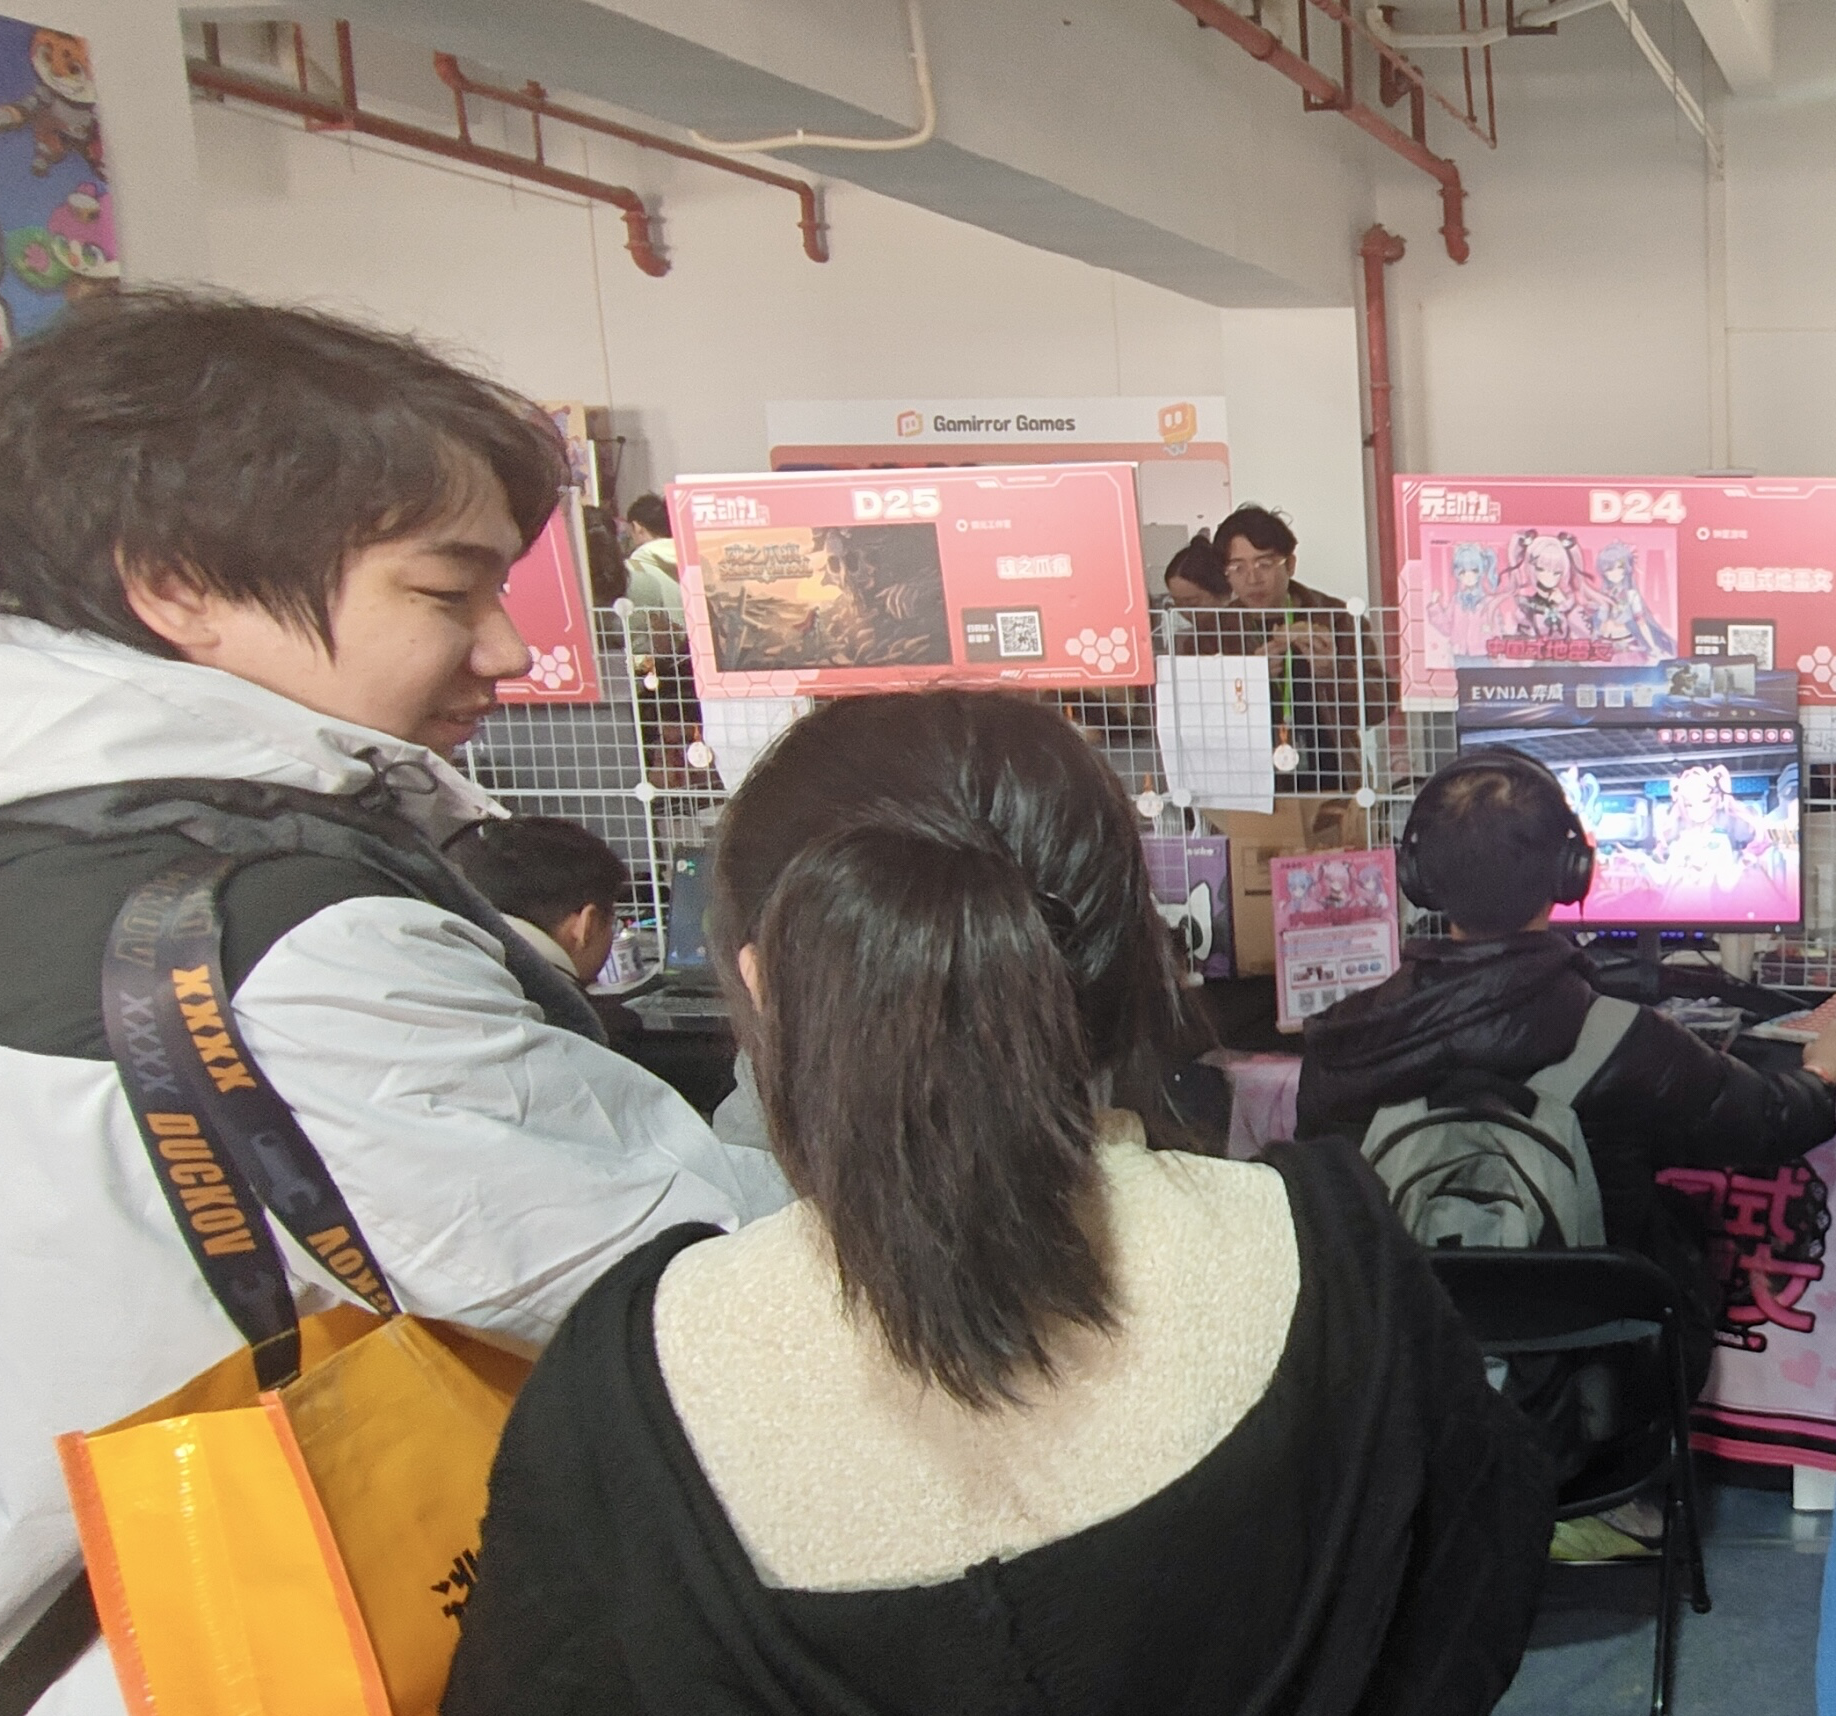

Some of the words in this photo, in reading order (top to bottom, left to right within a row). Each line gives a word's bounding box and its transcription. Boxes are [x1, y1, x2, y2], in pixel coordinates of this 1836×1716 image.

[933, 415, 1011, 432] Gamirror
[1016, 414, 1076, 431] Games
[853, 487, 942, 520] D25
[1590, 489, 1686, 523] D24
[1471, 685, 1529, 701] EVNIA
[120, 991, 179, 1095] XXXX
[172, 964, 258, 1094] XXXX
[144, 1112, 257, 1257] DUCKOV
